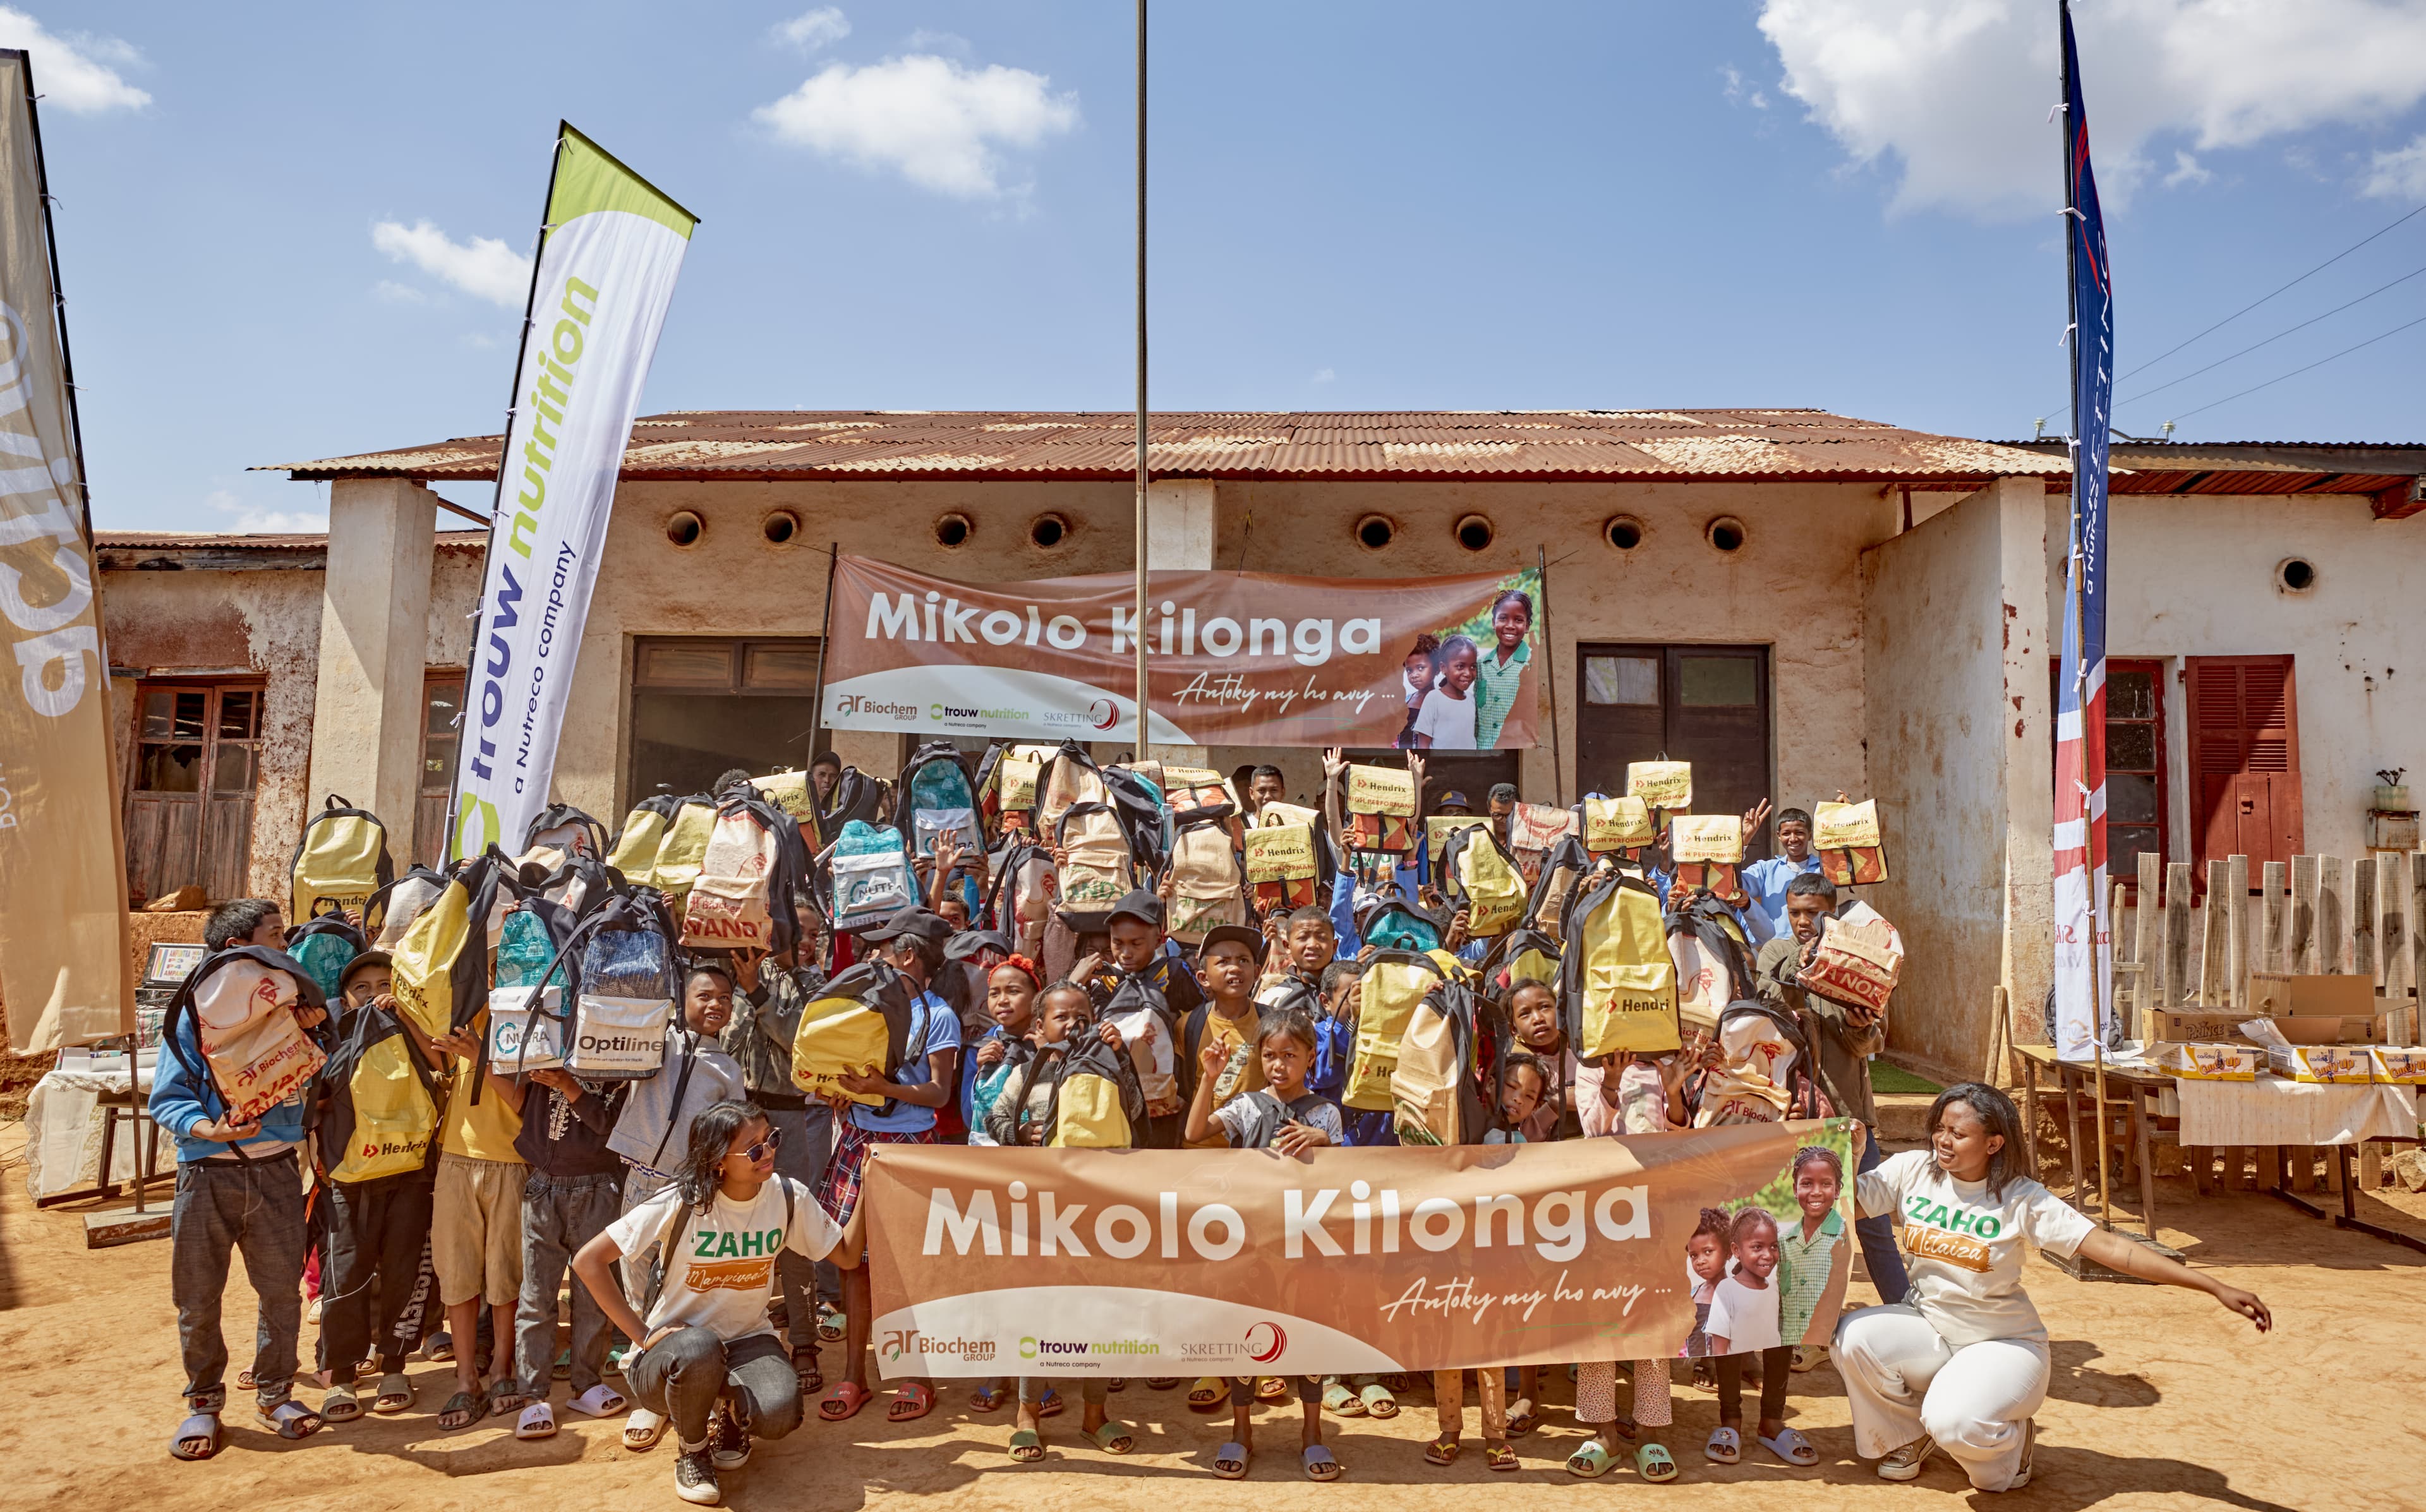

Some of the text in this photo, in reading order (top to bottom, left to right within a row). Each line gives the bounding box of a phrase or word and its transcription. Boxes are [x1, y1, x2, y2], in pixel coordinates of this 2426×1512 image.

[471, 275, 599, 781] trouw nutrition
[2086, 582, 2094, 595] a
[865, 591, 1381, 667] Mikolo Kilonga
[515, 540, 576, 795] a Nutreco company
[1173, 671, 1261, 714] Antoky
[1264, 688, 1298, 715] ny
[1303, 674, 1332, 704] ho
[1334, 688, 1375, 715] avy
[837, 694, 917, 715] ar Biochem
[944, 705, 1029, 720] trouw nutrition
[1044, 712, 1102, 724] SKRETTING
[1370, 782, 1406, 793] Hendrix
[1647, 777, 1681, 788] Hendrix
[1608, 819, 1643, 829] Hendrix
[1833, 818, 1869, 829] Hendrix
[1694, 834, 1732, 843] Hendrix
[1268, 846, 1305, 857] Hendrix
[1248, 865, 1267, 874] HIGH
[395, 971, 429, 1009] Hedrix
[506, 1030, 550, 1045] NURA
[2185, 1024, 2224, 1040] PRINCE
[579, 1035, 664, 1053] Optiline
[922, 1179, 1651, 1263] Mikolo Kilonga
[1905, 1227, 1982, 1261] Mitaiza
[1379, 1275, 1496, 1325] Antoky
[1502, 1289, 1547, 1322] ny
[1553, 1269, 1584, 1303] ho
[1591, 1284, 1646, 1317] avy
[881, 1329, 996, 1356] ar Biochem
[1039, 1339, 1159, 1355] trouw nutrition
[1181, 1342, 1262, 1355] SKRETTING
[963, 1353, 996, 1362] GROUP
